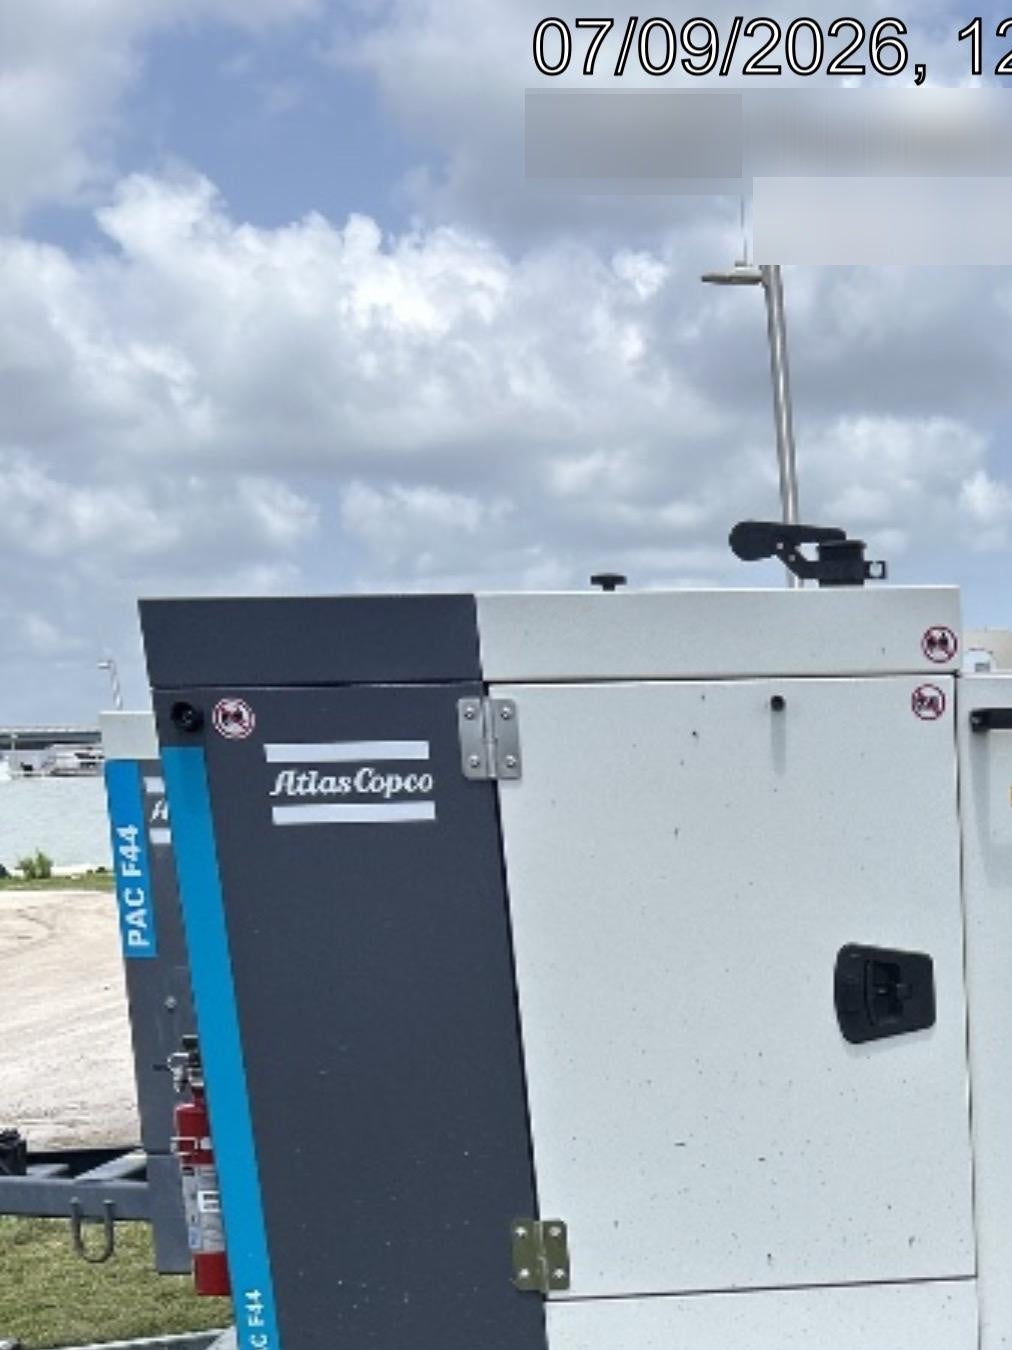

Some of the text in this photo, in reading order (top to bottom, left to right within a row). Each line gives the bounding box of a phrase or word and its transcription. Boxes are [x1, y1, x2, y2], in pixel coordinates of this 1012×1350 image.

[116, 823, 150, 947] PAC F44
[244, 1288, 265, 1328] F44
